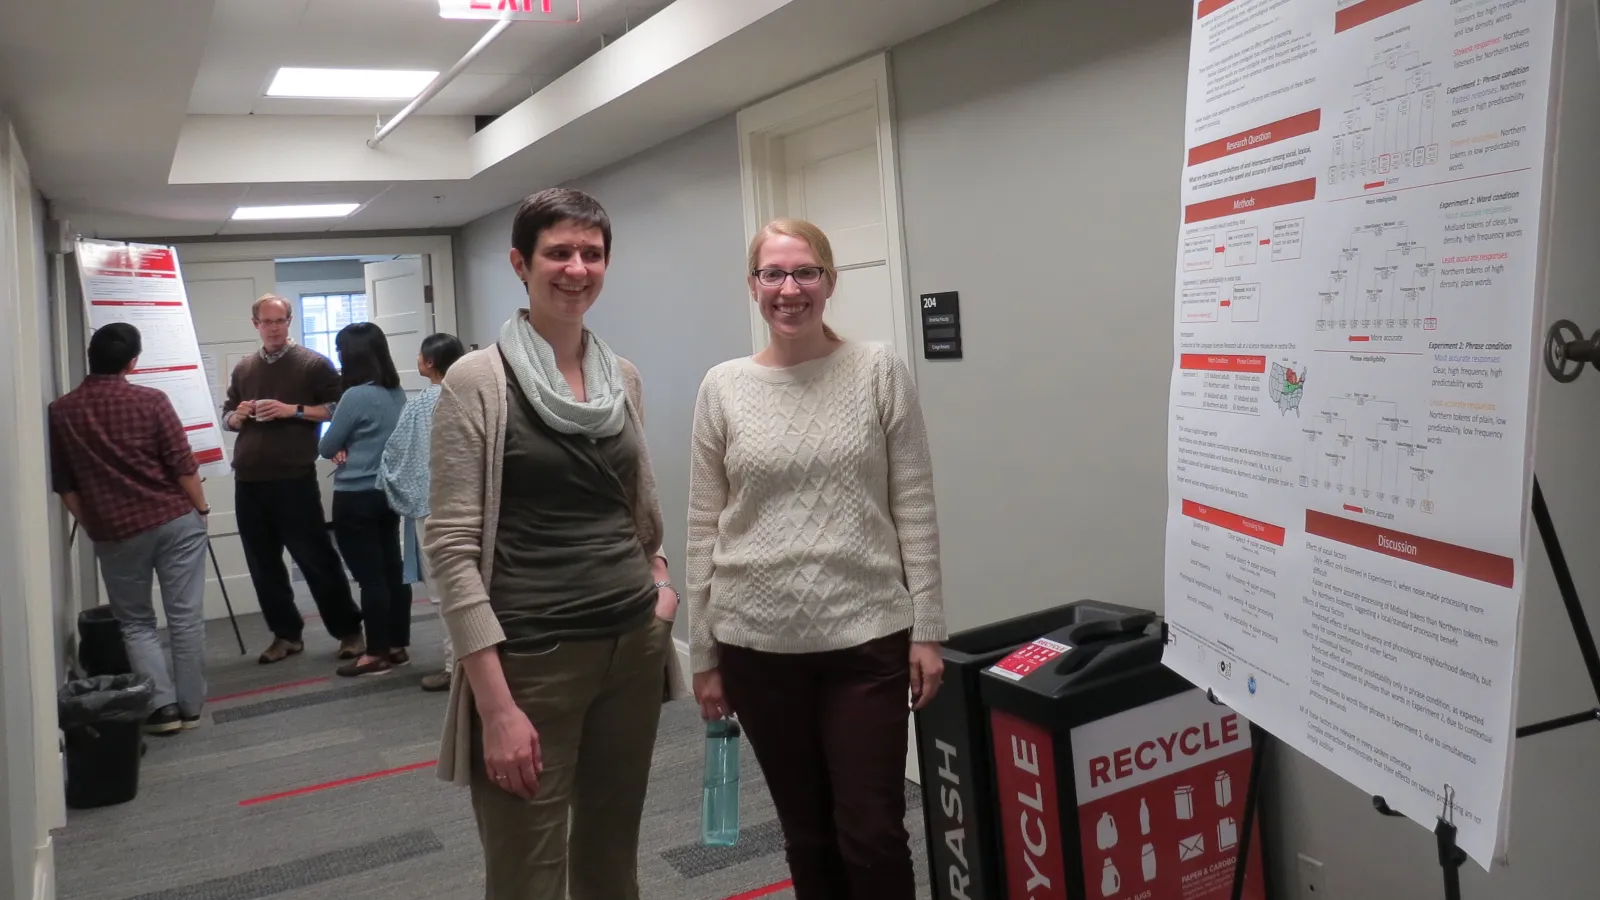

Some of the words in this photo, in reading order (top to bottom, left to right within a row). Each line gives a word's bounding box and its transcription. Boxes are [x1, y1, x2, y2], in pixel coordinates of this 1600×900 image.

[1454, 57, 1474, 69] listeners
[1484, 46, 1509, 59] Northern
[1510, 40, 1529, 51] tokens
[1447, 81, 1475, 94] Experiment
[1483, 74, 1500, 84] Phrase
[1502, 66, 1529, 78] condition
[1500, 80, 1526, 91] Northern
[1452, 107, 1469, 116] tokens
[1476, 101, 1487, 111] high
[1488, 93, 1524, 108] predictability
[1451, 120, 1467, 128] words
[1501, 126, 1526, 136] Northern
[1226, 137, 1247, 151] Research
[1248, 132, 1271, 146] Question
[1450, 150, 1466, 160] tokens
[1485, 140, 1520, 154] predictability
[1449, 163, 1463, 171] words
[1234, 197, 1255, 209] Methods
[1440, 199, 1468, 210] Experiment
[1477, 194, 1491, 203] Word
[1492, 191, 1519, 201] condition
[1464, 234, 1475, 243] high
[1477, 232, 1504, 241] frequency
[1466, 266, 1483, 274] tokens
[1492, 264, 1504, 274] high
[1461, 279, 1473, 288] plain
[924, 297, 936, 308] 204
[1429, 342, 1458, 350] Experiment
[1448, 367, 1459, 376] high
[1490, 368, 1502, 378] high
[1432, 379, 1465, 388] predictability
[1429, 411, 1452, 419] Northern
[1453, 413, 1470, 421] tokens
[1496, 416, 1506, 424] low
[1463, 426, 1472, 434] low
[1474, 428, 1503, 439] frequency
[1364, 507, 1375, 515] More
[1376, 510, 1394, 520] accurate
[1378, 535, 1416, 555] Discussion
[1399, 583, 1411, 592] when
[1412, 587, 1425, 596] noise
[1426, 591, 1439, 601] made
[1441, 596, 1468, 612] processing
[1470, 604, 1484, 614] more
[1410, 611, 1425, 622] tokens
[1426, 616, 1437, 625] than
[1439, 620, 1462, 636] Northern
[1484, 637, 1498, 646] even
[1414, 626, 1439, 642] processing
[1482, 676, 1491, 686] but
[1409, 688, 1425, 700] phrase
[1459, 710, 1484, 726] expected
[1412, 700, 1439, 720] Experiment
[1446, 716, 1456, 727] due
[1458, 722, 1463, 730] to
[1464, 726, 1492, 744] contextual
[1089, 713, 1238, 788] RECYCLE
[1424, 734, 1434, 743] due
[1435, 738, 1440, 746] to
[1442, 743, 1476, 764] simultaneous
[1011, 735, 1051, 900] YCLE
[1182, 871, 1202, 882] PAPER
